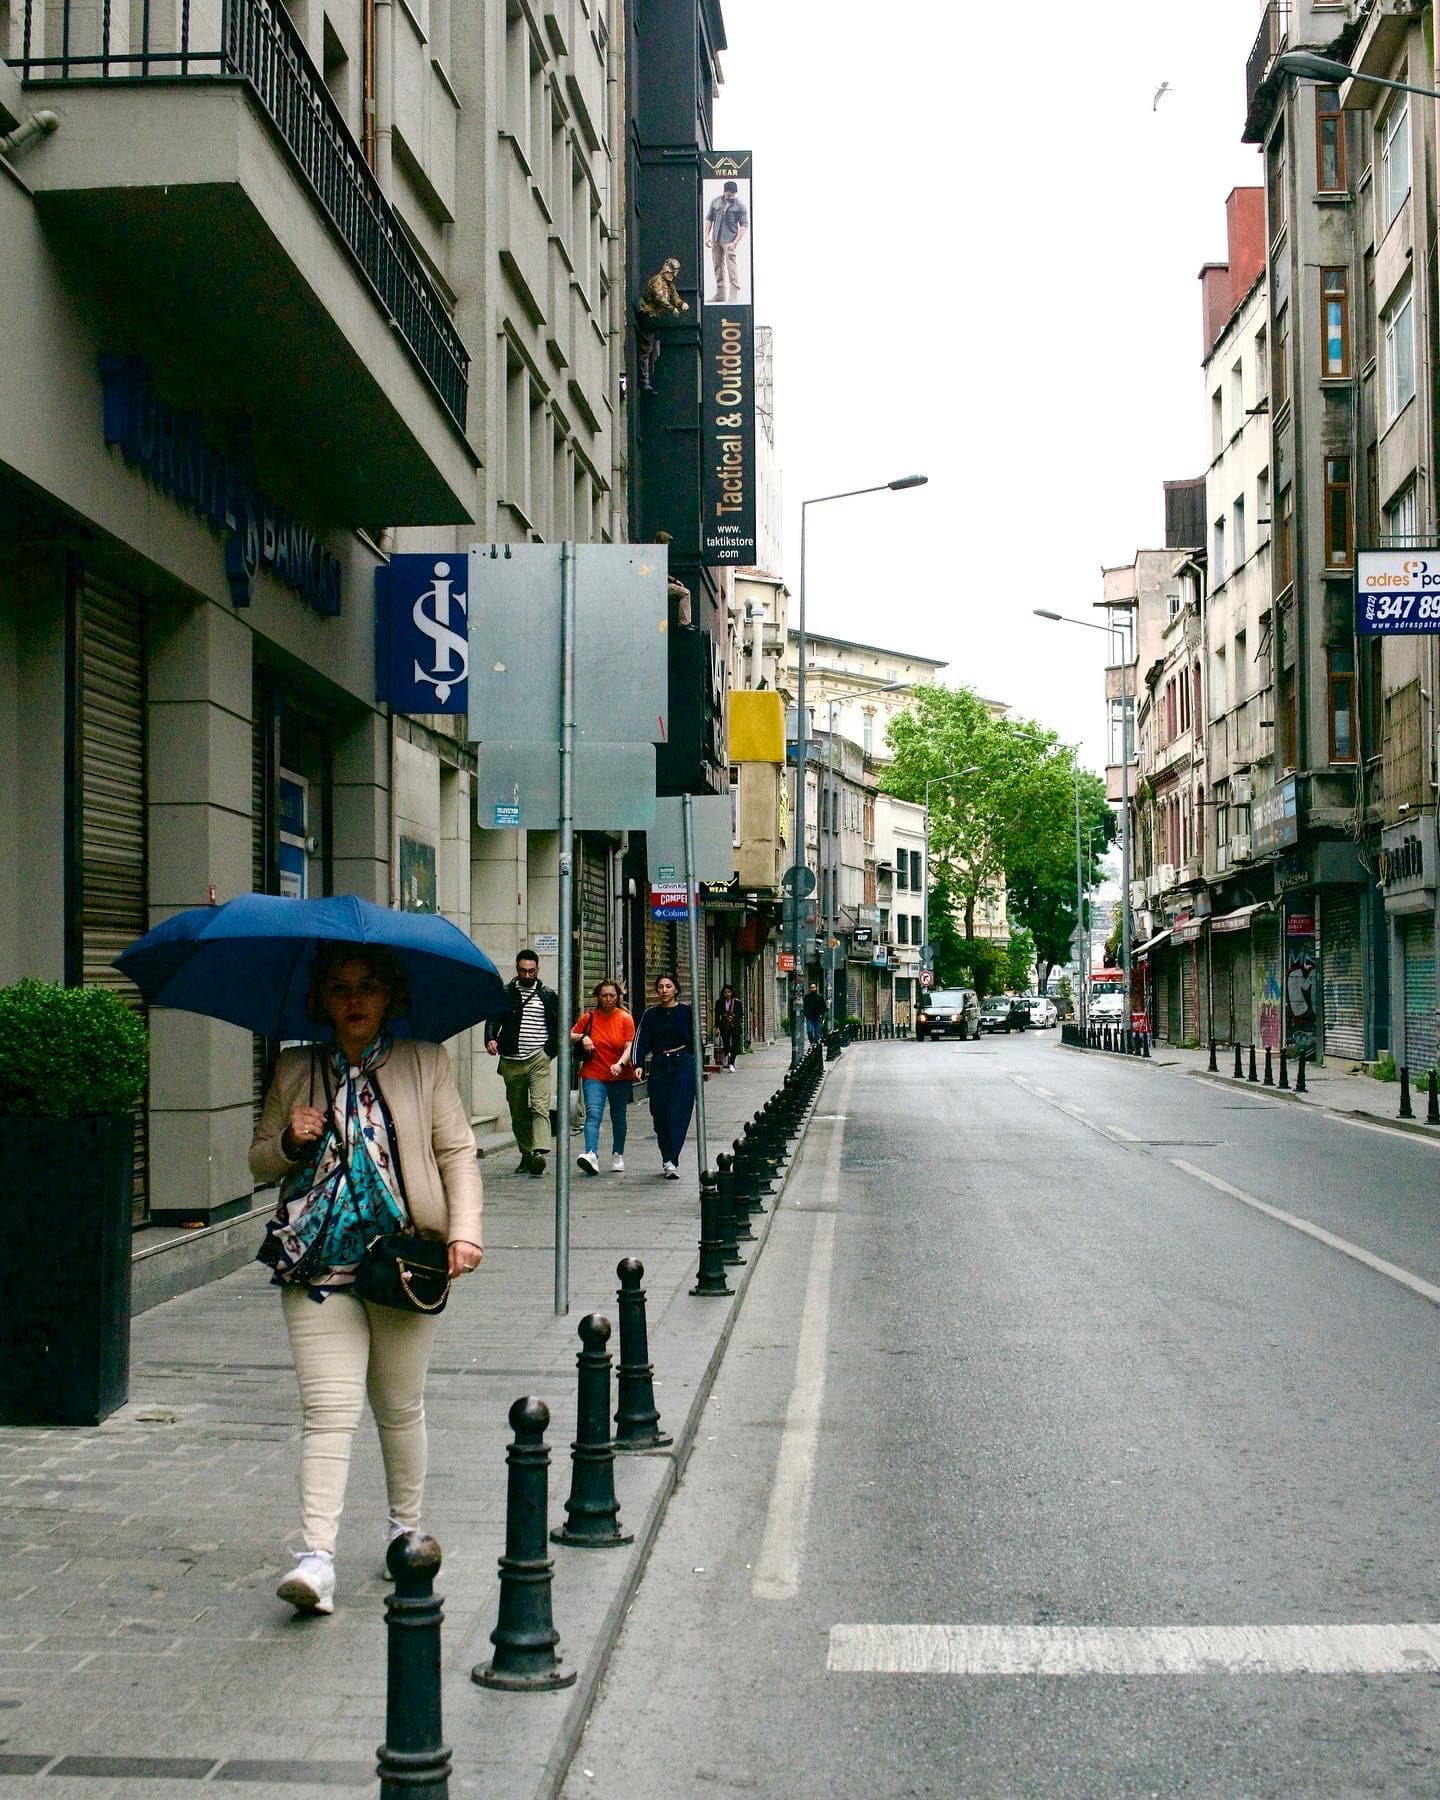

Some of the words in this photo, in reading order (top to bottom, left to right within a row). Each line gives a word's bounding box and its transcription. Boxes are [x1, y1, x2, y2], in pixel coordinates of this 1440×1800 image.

[715, 318, 742, 406] Outdoor
[717, 413, 742, 428] &
[716, 434, 743, 516] Tactical
[717, 525, 742, 534] www.
[706, 536, 754, 547] taktikstore
[717, 550, 739, 559] .com
[1366, 573, 1409, 586] adres
[1377, 596, 1416, 620] 347
